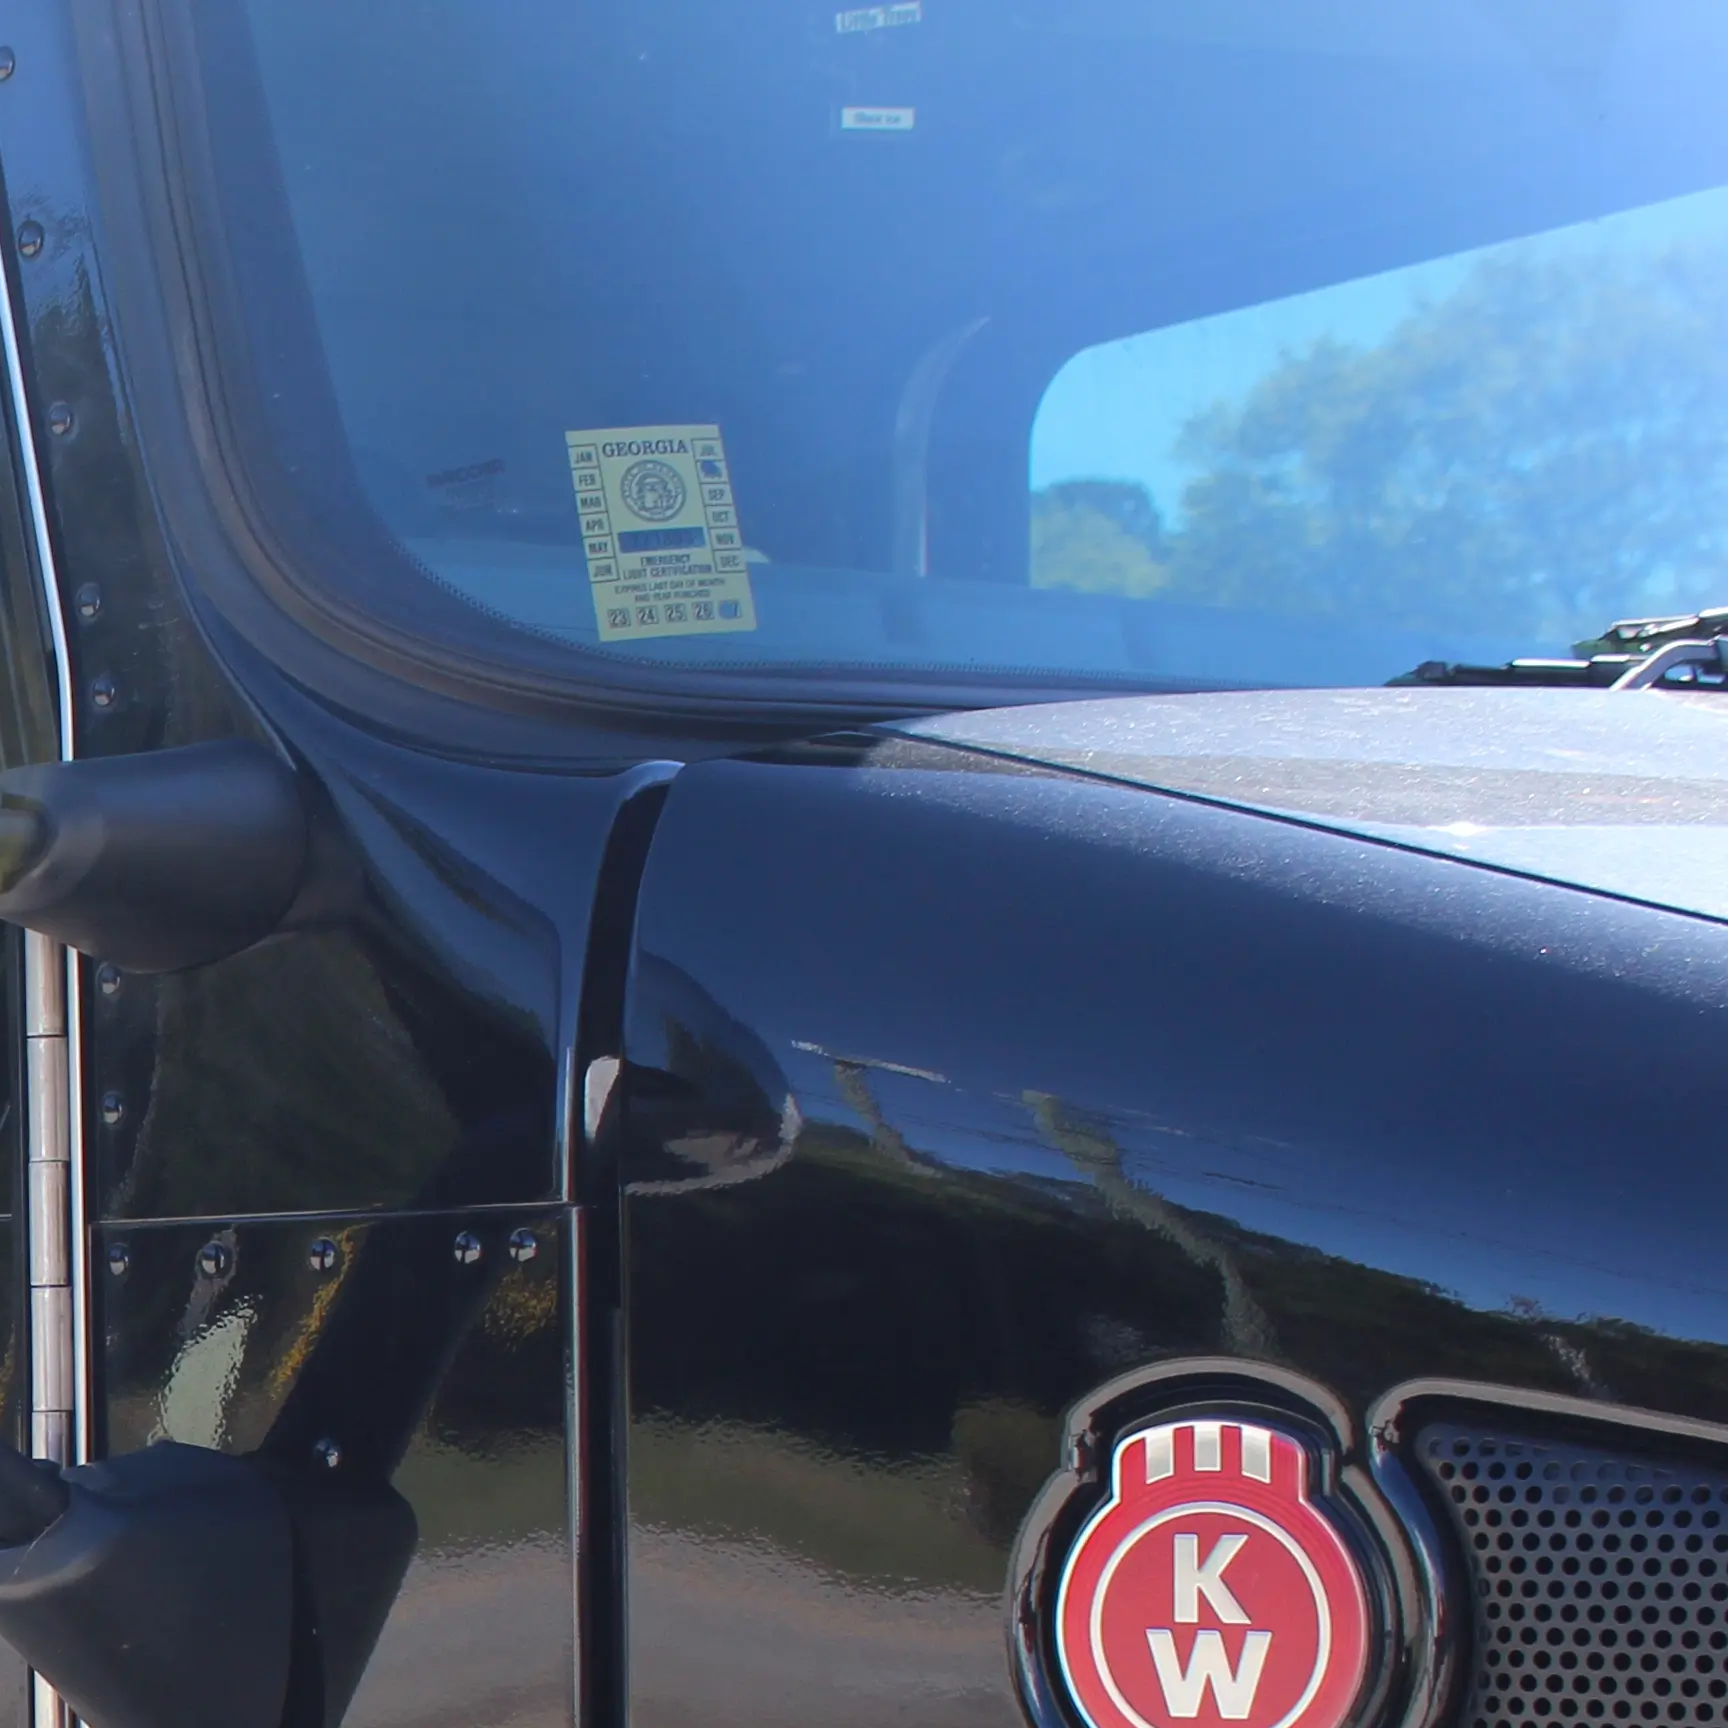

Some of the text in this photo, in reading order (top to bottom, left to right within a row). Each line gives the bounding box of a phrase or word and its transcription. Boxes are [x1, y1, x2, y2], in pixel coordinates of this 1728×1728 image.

[602, 439, 689, 458] GEORGIA
[574, 451, 593, 464] JAN
[579, 474, 596, 487] FEB
[708, 488, 725, 501] SEP
[580, 497, 602, 509] MAR
[712, 511, 730, 523] OCT
[586, 519, 605, 531] APR
[715, 533, 734, 545] NOV
[588, 542, 607, 554] MAY
[641, 554, 690, 567] EMERGENCY
[720, 555, 740, 567] DEC
[610, 609, 629, 627] 23
[638, 606, 657, 624] 24
[666, 603, 685, 622] 25
